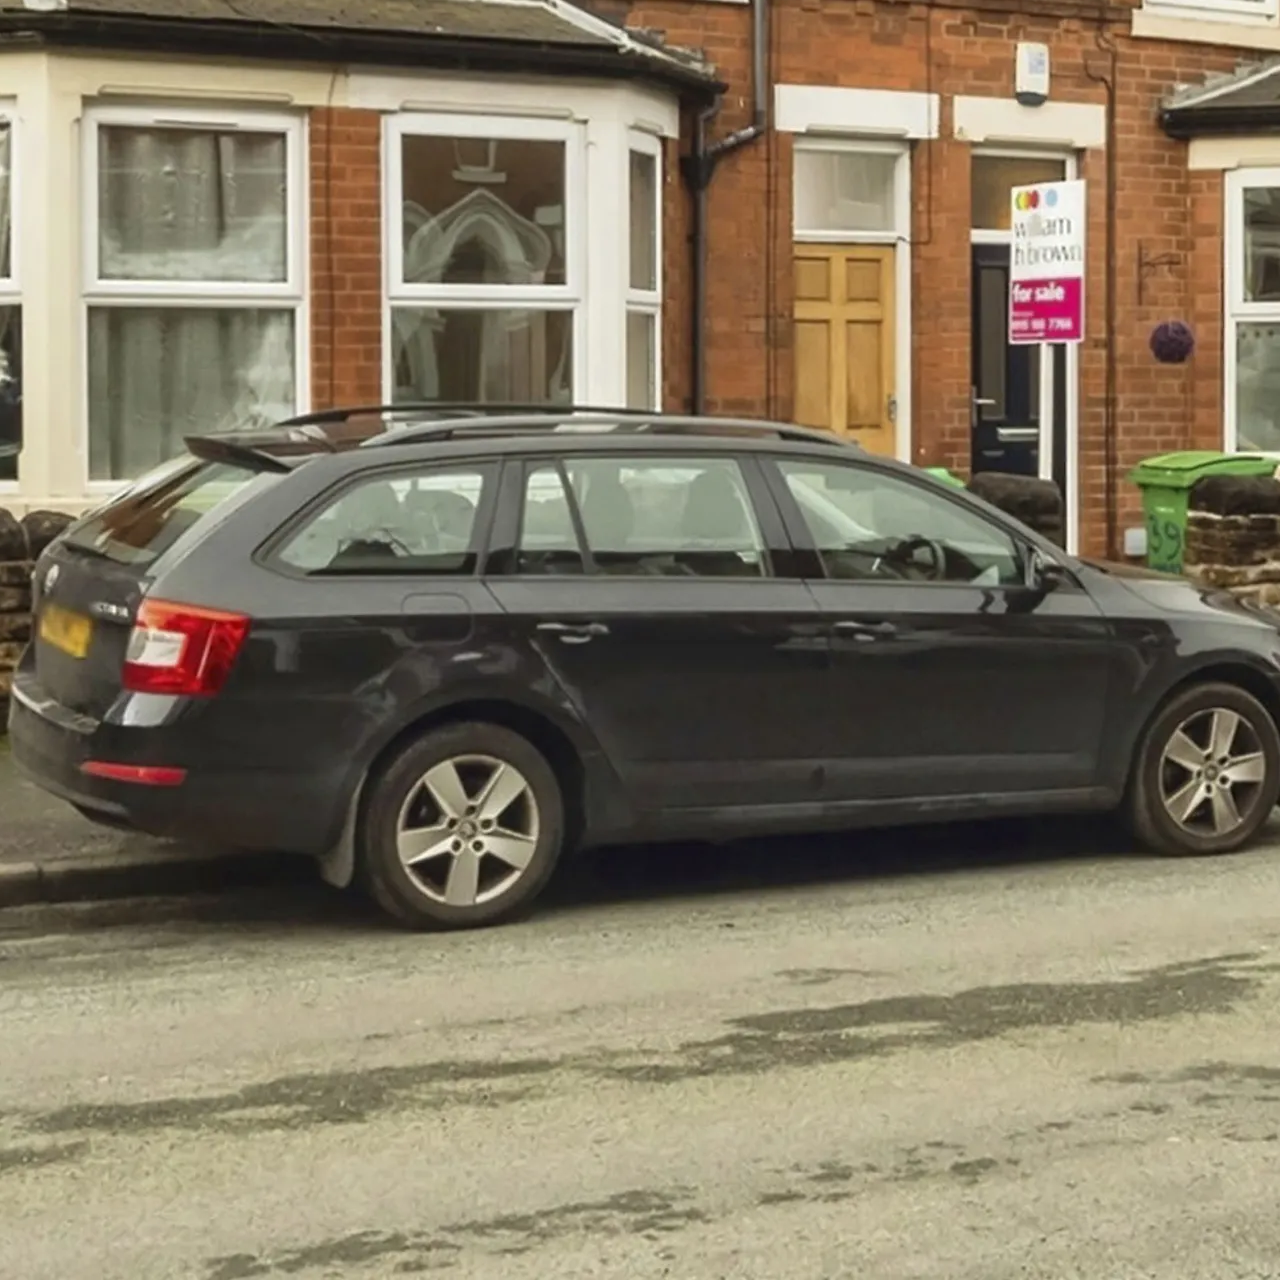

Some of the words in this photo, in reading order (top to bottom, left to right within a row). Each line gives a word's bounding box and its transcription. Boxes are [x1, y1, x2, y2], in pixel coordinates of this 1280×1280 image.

[1027, 241, 1082, 265] brown
[1013, 283, 1032, 303] for
[1035, 281, 1065, 302] sale
[1149, 514, 1181, 561] 39
